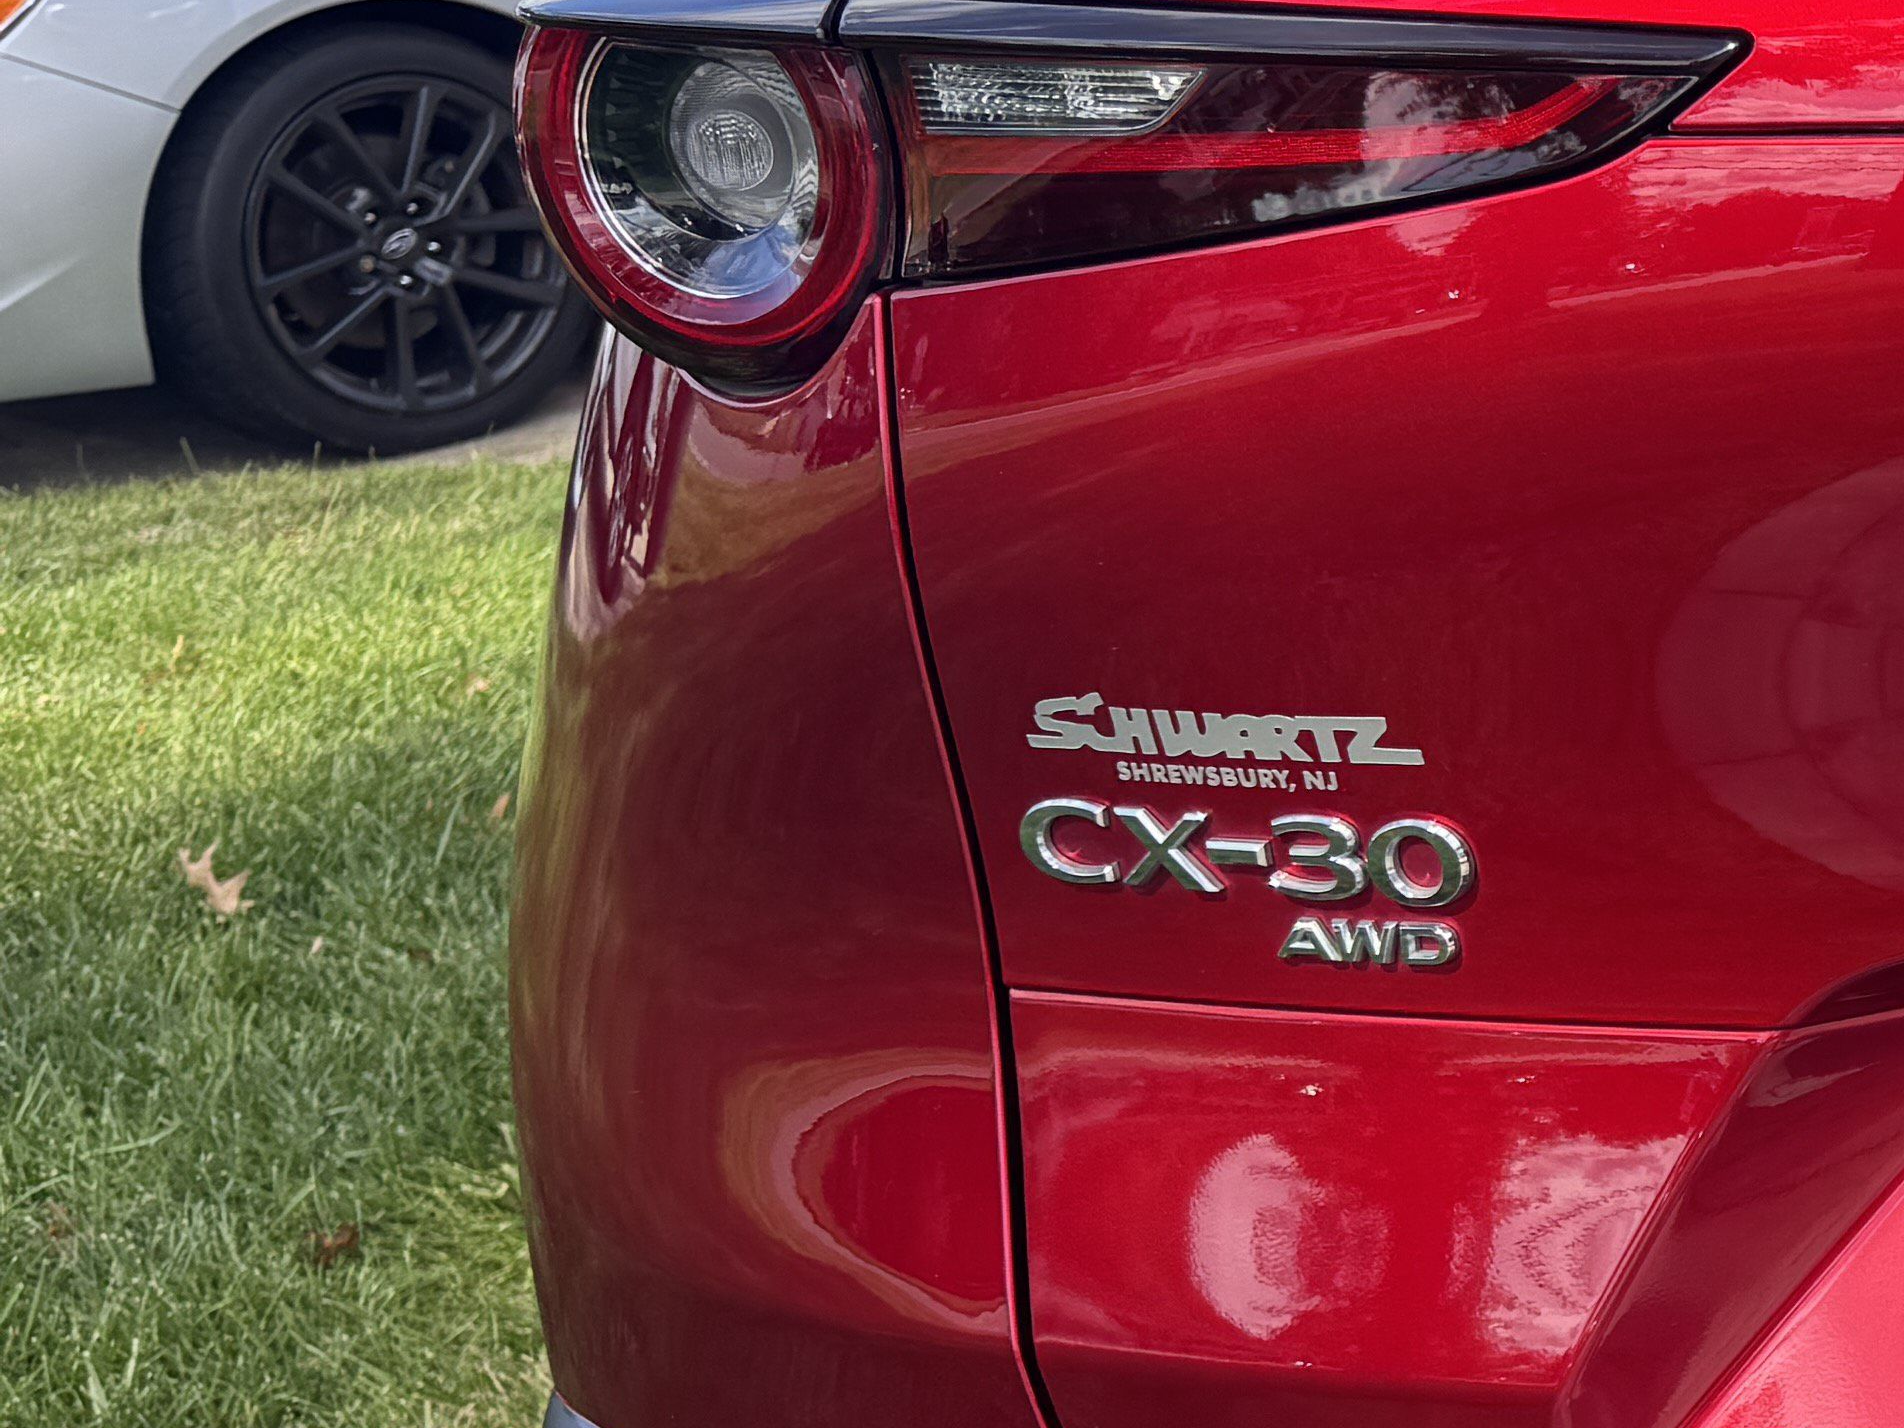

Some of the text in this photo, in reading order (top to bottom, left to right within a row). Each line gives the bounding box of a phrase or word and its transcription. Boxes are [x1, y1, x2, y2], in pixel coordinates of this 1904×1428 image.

[1117, 760, 1339, 793] SHREWSBURY, NJ
[1018, 797, 1478, 908] CX-30
[1277, 915, 1462, 967] AWD
